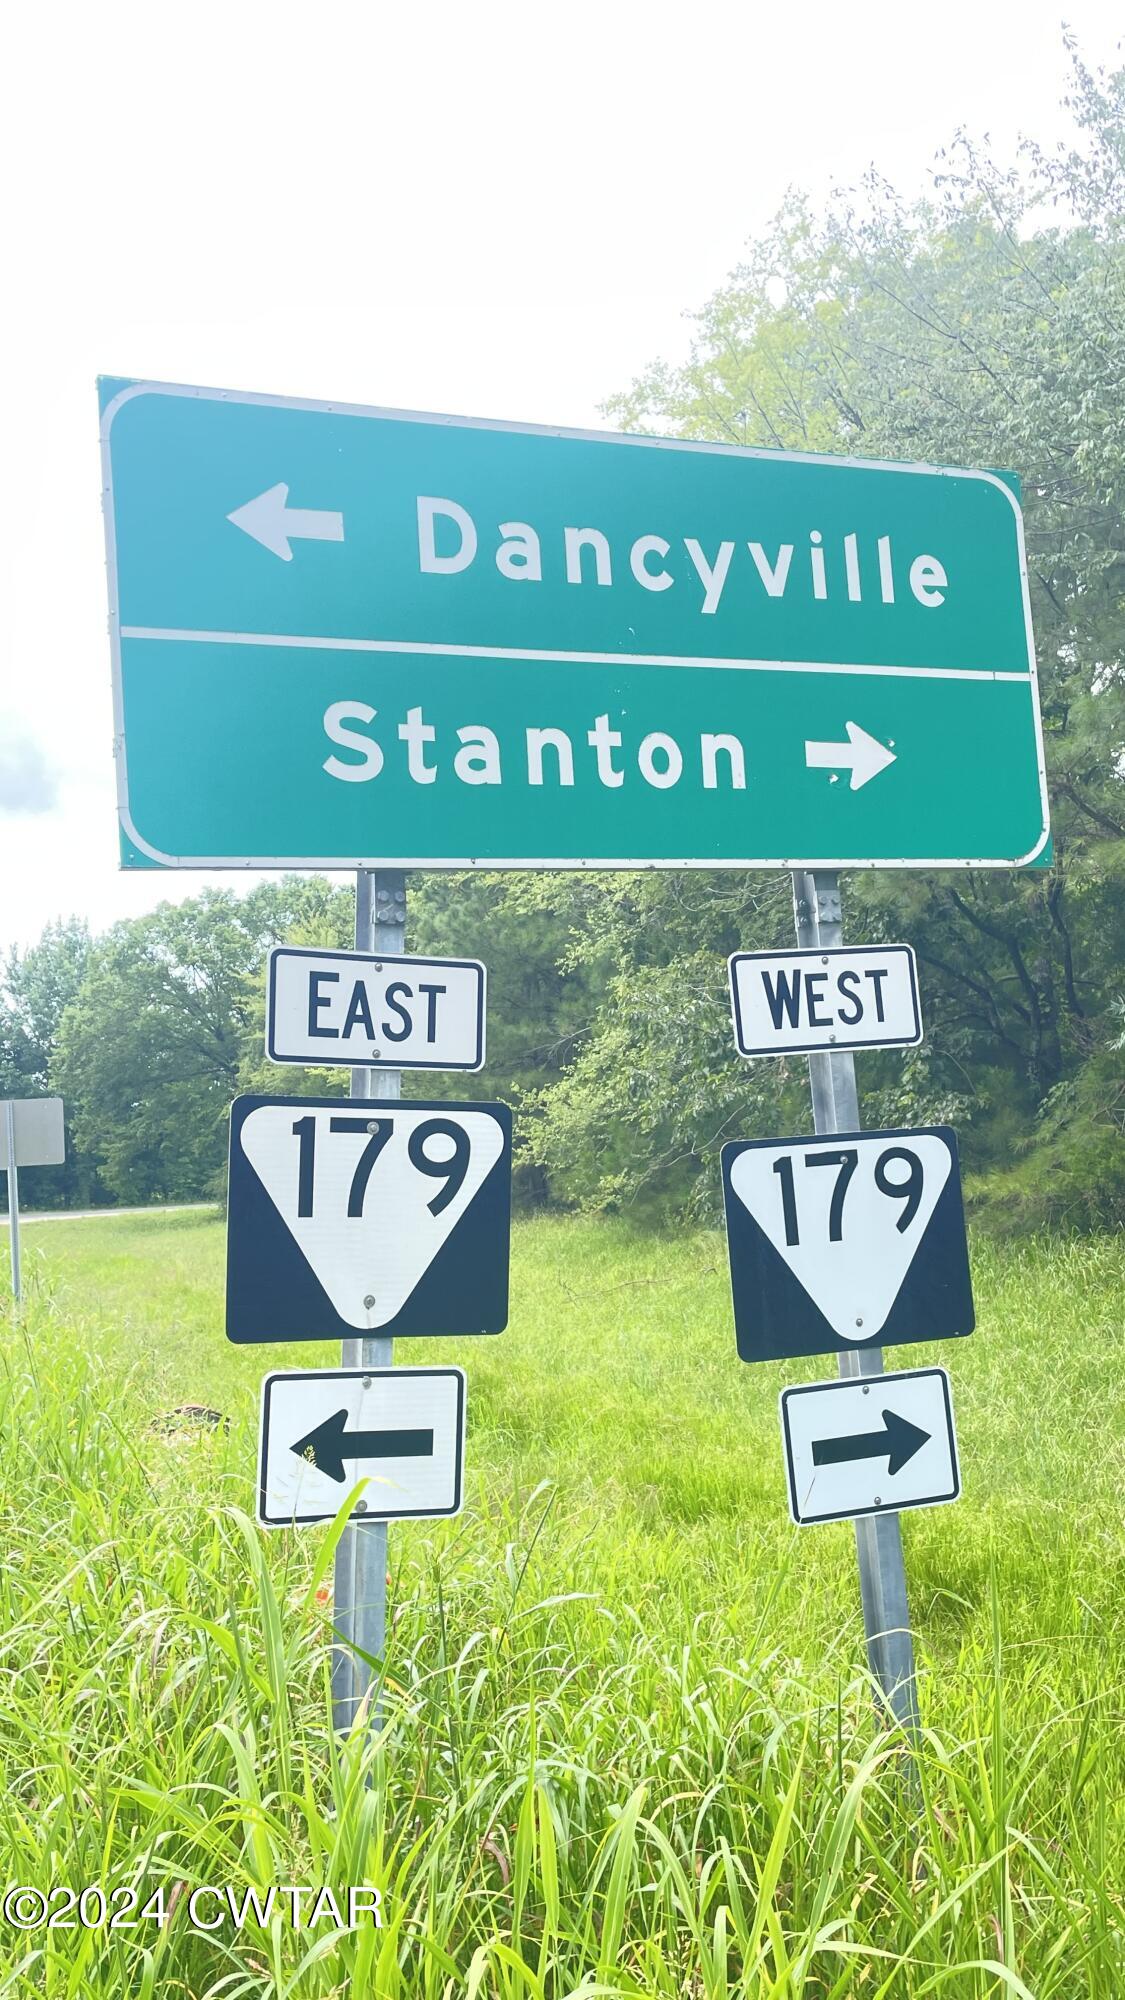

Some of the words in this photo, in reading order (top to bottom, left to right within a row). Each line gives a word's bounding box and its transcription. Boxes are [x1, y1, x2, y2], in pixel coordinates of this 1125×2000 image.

[417, 494, 949, 614] Dancyville
[322, 700, 746, 790] Stanton
[308, 971, 446, 1043] EAST
[761, 969, 888, 1030] WEST
[292, 1116, 471, 1218] 179
[772, 1147, 924, 1246] 179
